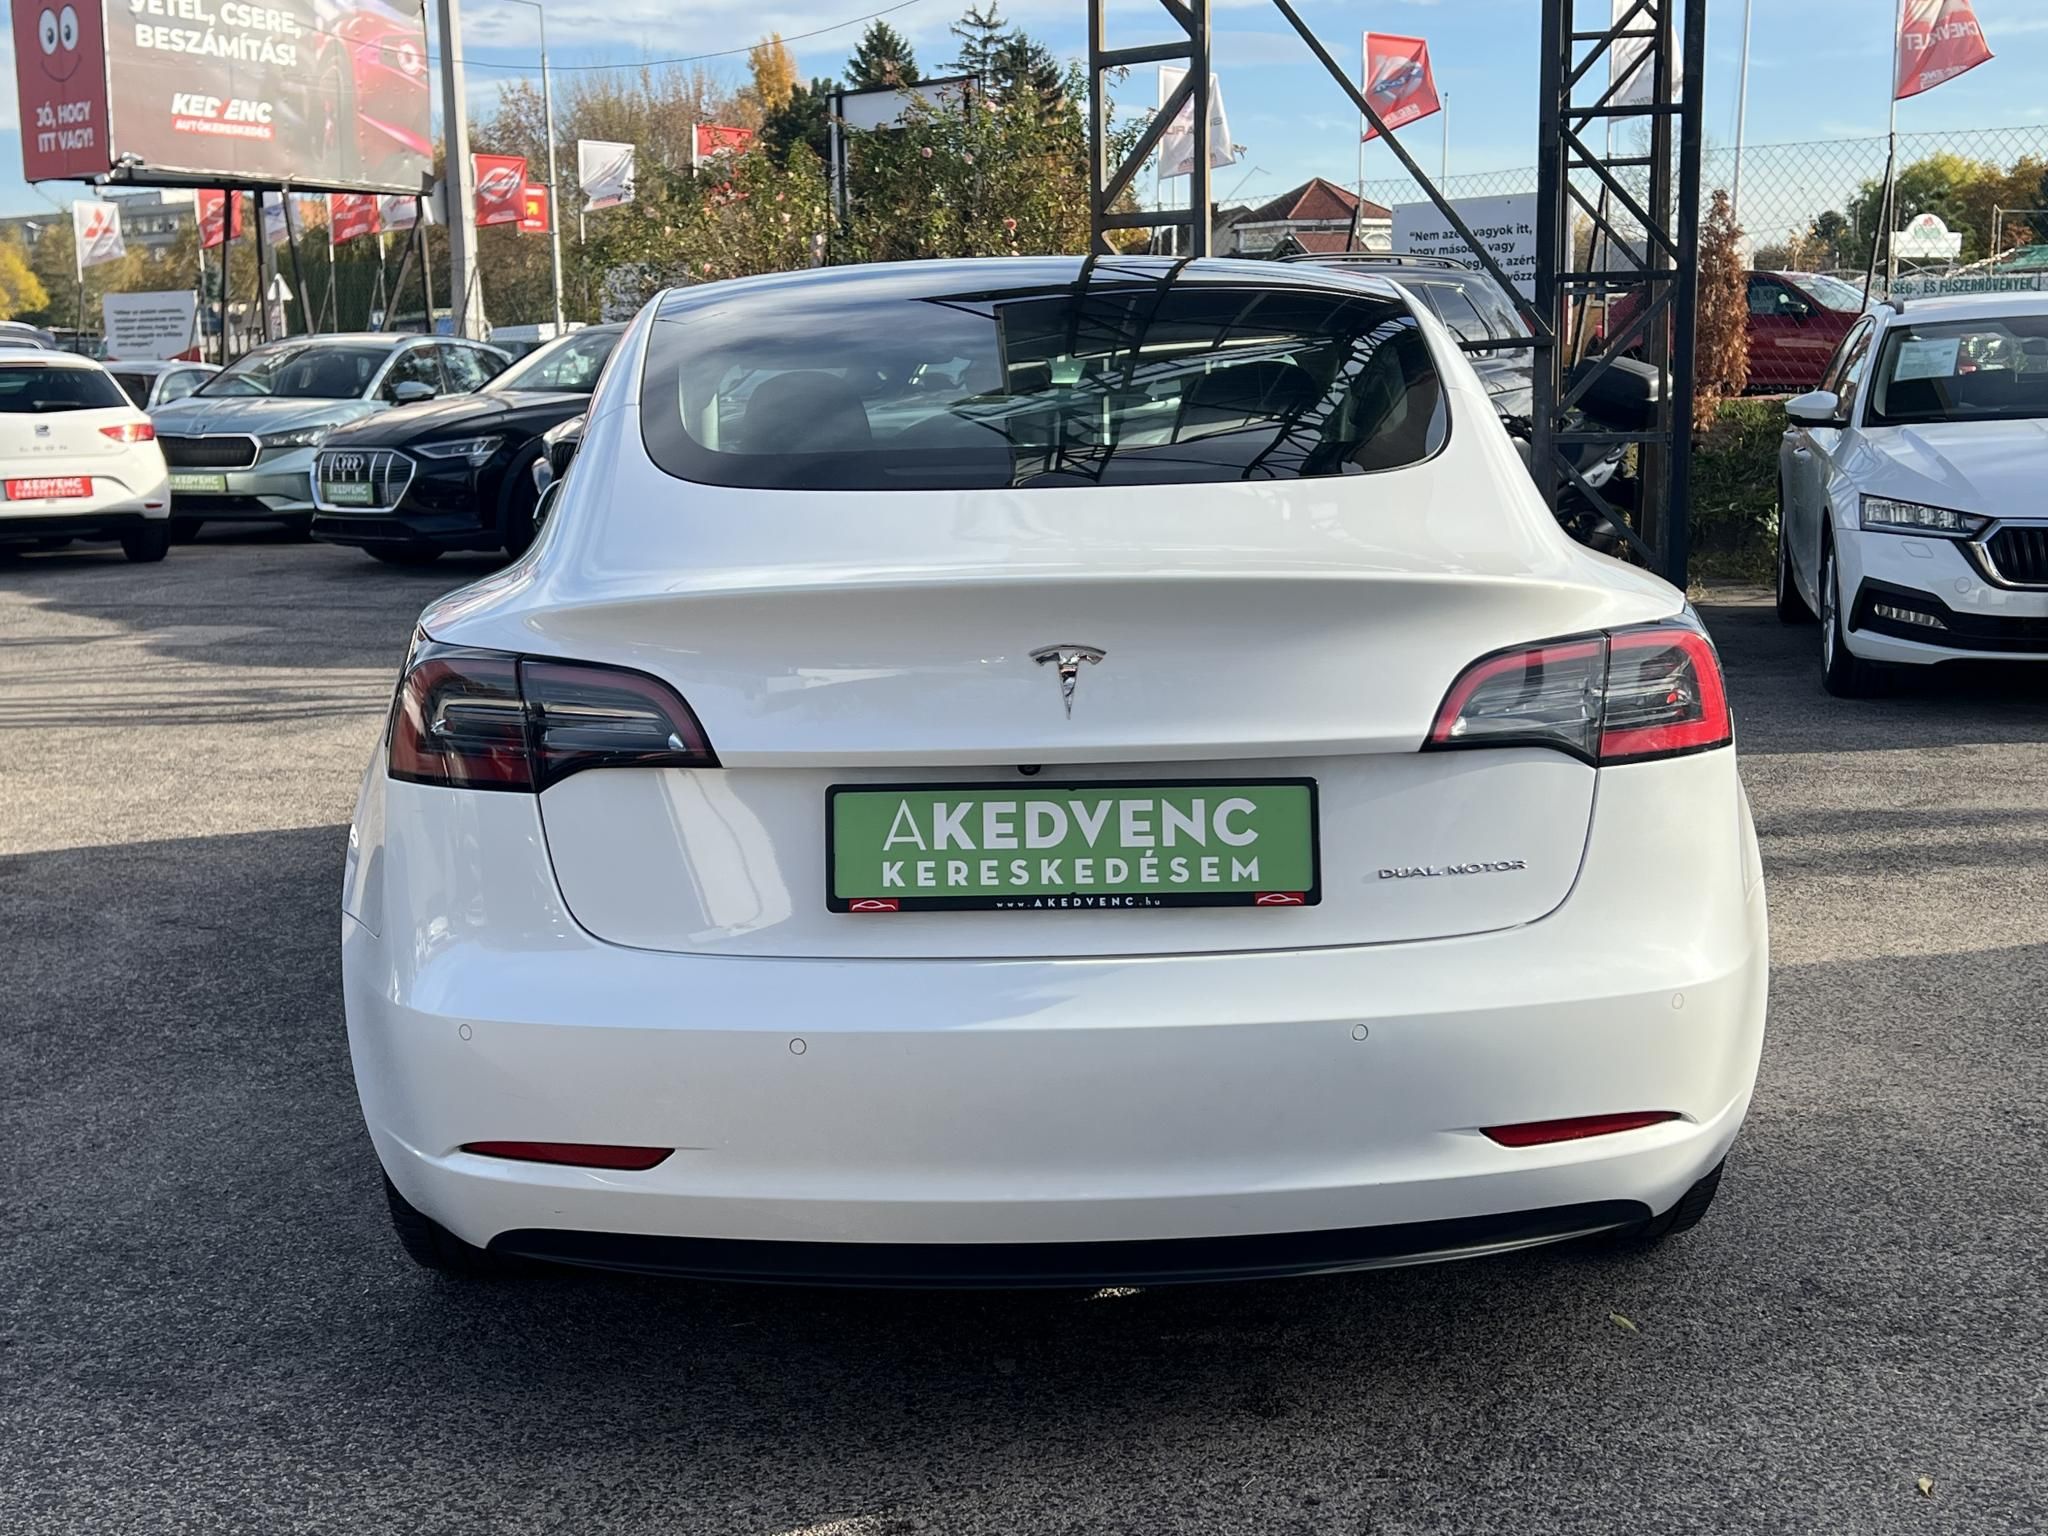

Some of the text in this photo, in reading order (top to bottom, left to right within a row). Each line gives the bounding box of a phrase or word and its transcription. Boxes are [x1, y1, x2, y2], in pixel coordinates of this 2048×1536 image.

[220, 2, 301, 39] CSERE,
[135, 24, 298, 67] BESZÁMÍTÁS!
[57, 101, 91, 124] HOGY
[38, 127, 94, 153] ITT VAGY!
[1472, 225, 1512, 239] vagyok
[1516, 222, 1533, 236] itt,
[1488, 242, 1516, 254] vagy
[882, 797, 1259, 851] AKEDVENC
[882, 849, 1260, 888] KERESKEDÉSEM
[1378, 860, 1528, 879] DUAL MOTOR
[996, 896, 1160, 908] www.AKEDVENC.hu
